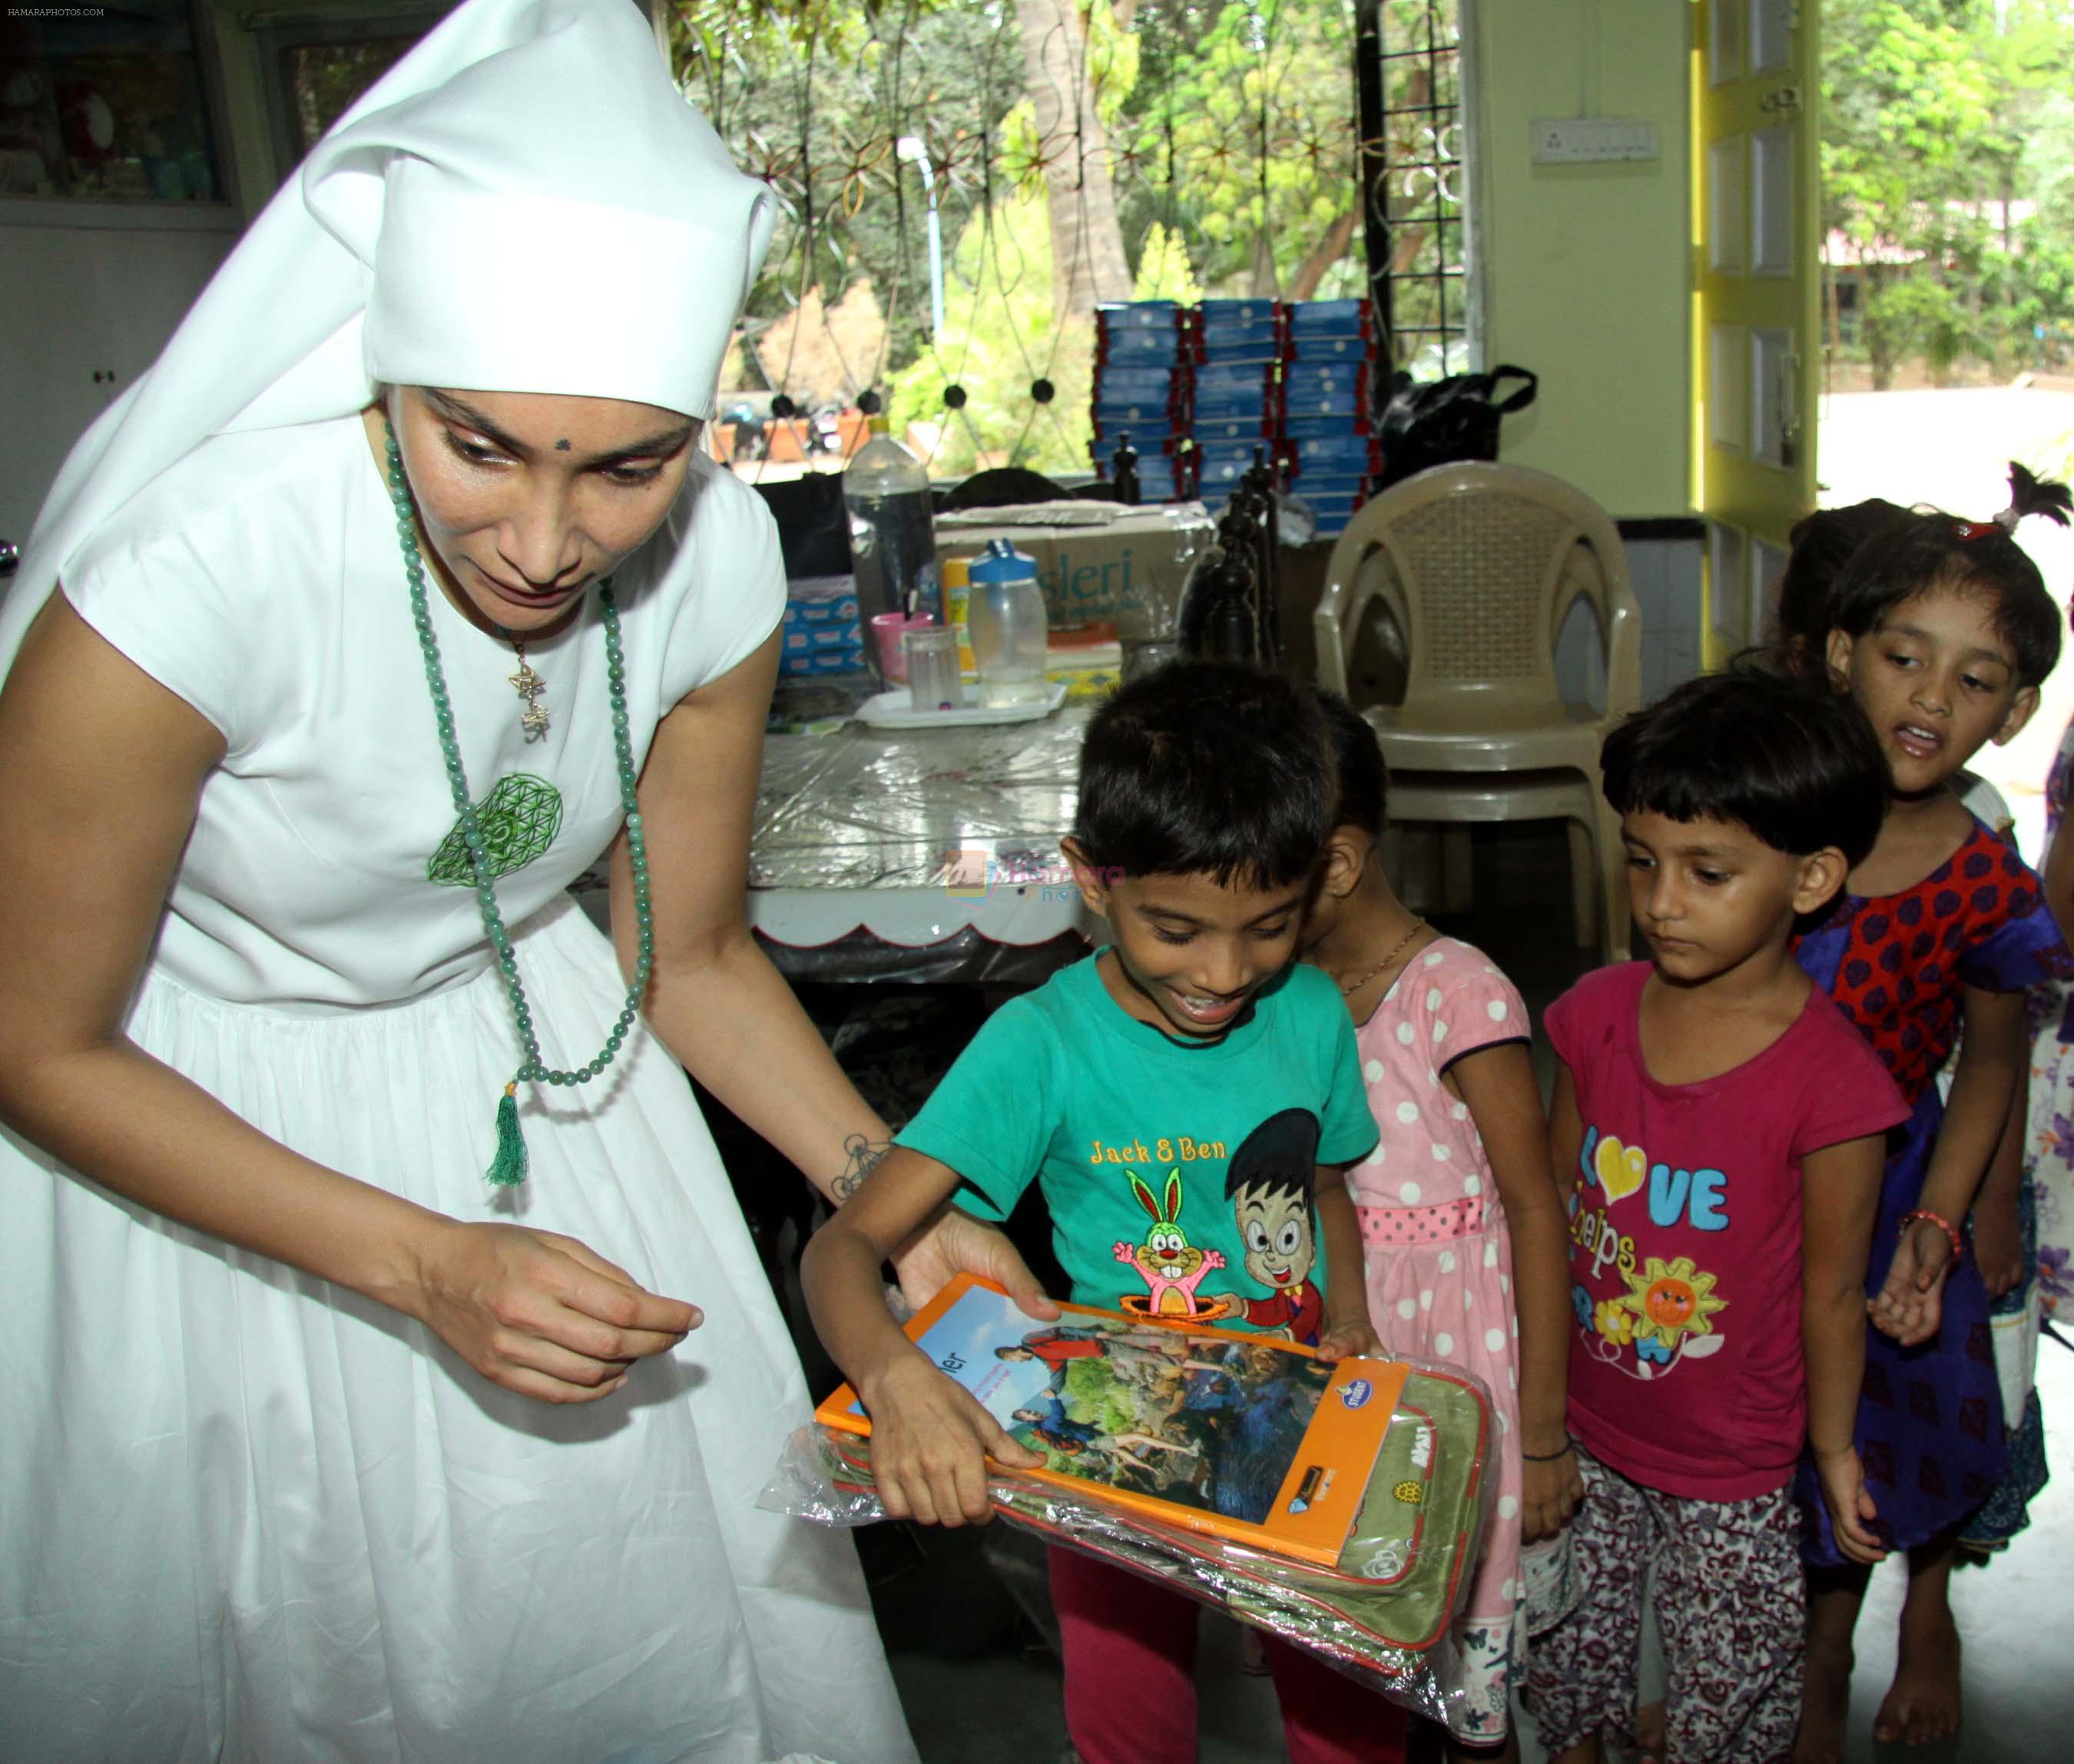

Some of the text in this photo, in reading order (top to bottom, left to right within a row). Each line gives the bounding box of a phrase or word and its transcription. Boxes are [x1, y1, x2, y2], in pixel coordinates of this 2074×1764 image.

[1090, 1137, 1227, 1164] Jack & Ben
